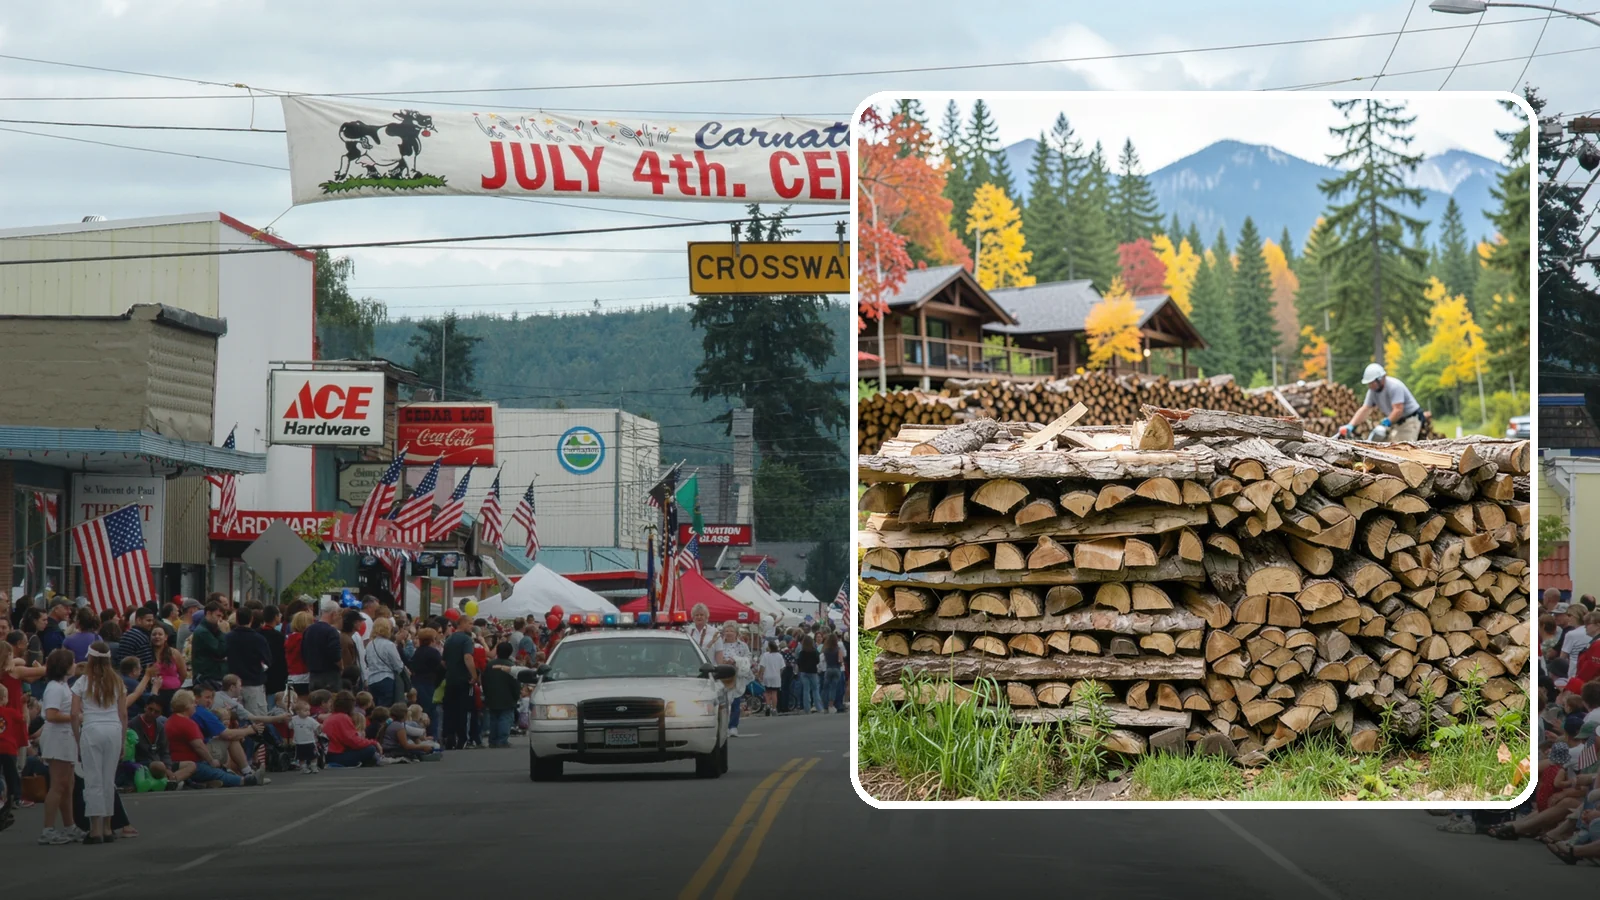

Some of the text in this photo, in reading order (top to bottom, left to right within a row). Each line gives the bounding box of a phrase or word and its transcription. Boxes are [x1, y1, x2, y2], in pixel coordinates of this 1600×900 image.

[481, 141, 604, 193] JULY
[632, 150, 746, 197] 4th.
[697, 254, 850, 280] CROSSWA
[283, 380, 373, 420] ACE
[405, 409, 485, 422] CEDAR LOG
[283, 421, 371, 436] Hardware
[416, 428, 477, 447] Coca-Cola
[353, 467, 384, 479] Simpl
[83, 485, 155, 495] St. Vincent de Paul
[81, 503, 154, 522] THT
[688, 526, 741, 535] CRNATION
[699, 535, 730, 543] GLASS
